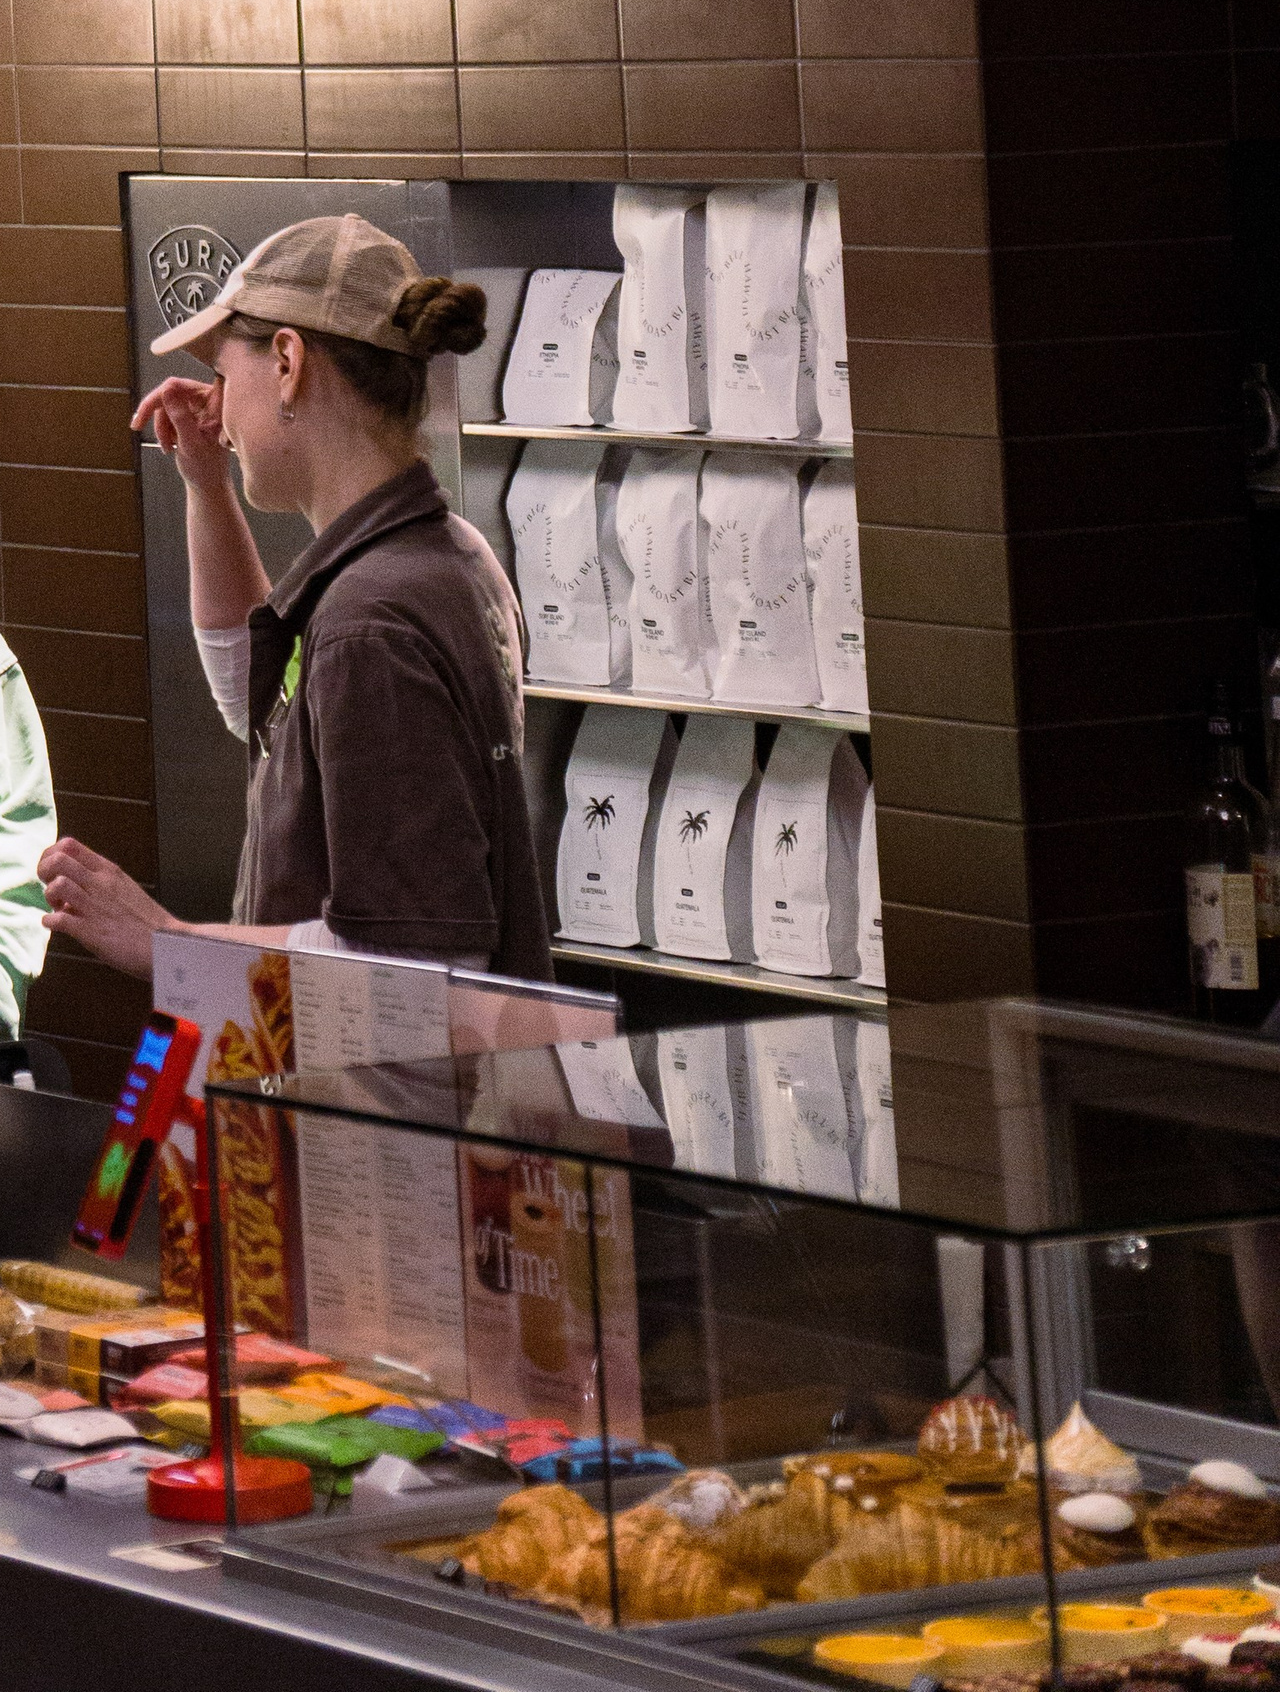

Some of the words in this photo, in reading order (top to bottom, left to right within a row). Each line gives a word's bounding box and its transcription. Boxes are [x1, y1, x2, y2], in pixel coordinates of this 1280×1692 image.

[156, 239, 233, 280] SURF
[745, 321, 780, 341] ROAST
[649, 583, 685, 604] ROAST
[749, 591, 788, 611] ROAST
[522, 1162, 620, 1239] Wheel
[489, 1227, 561, 1302] Time
